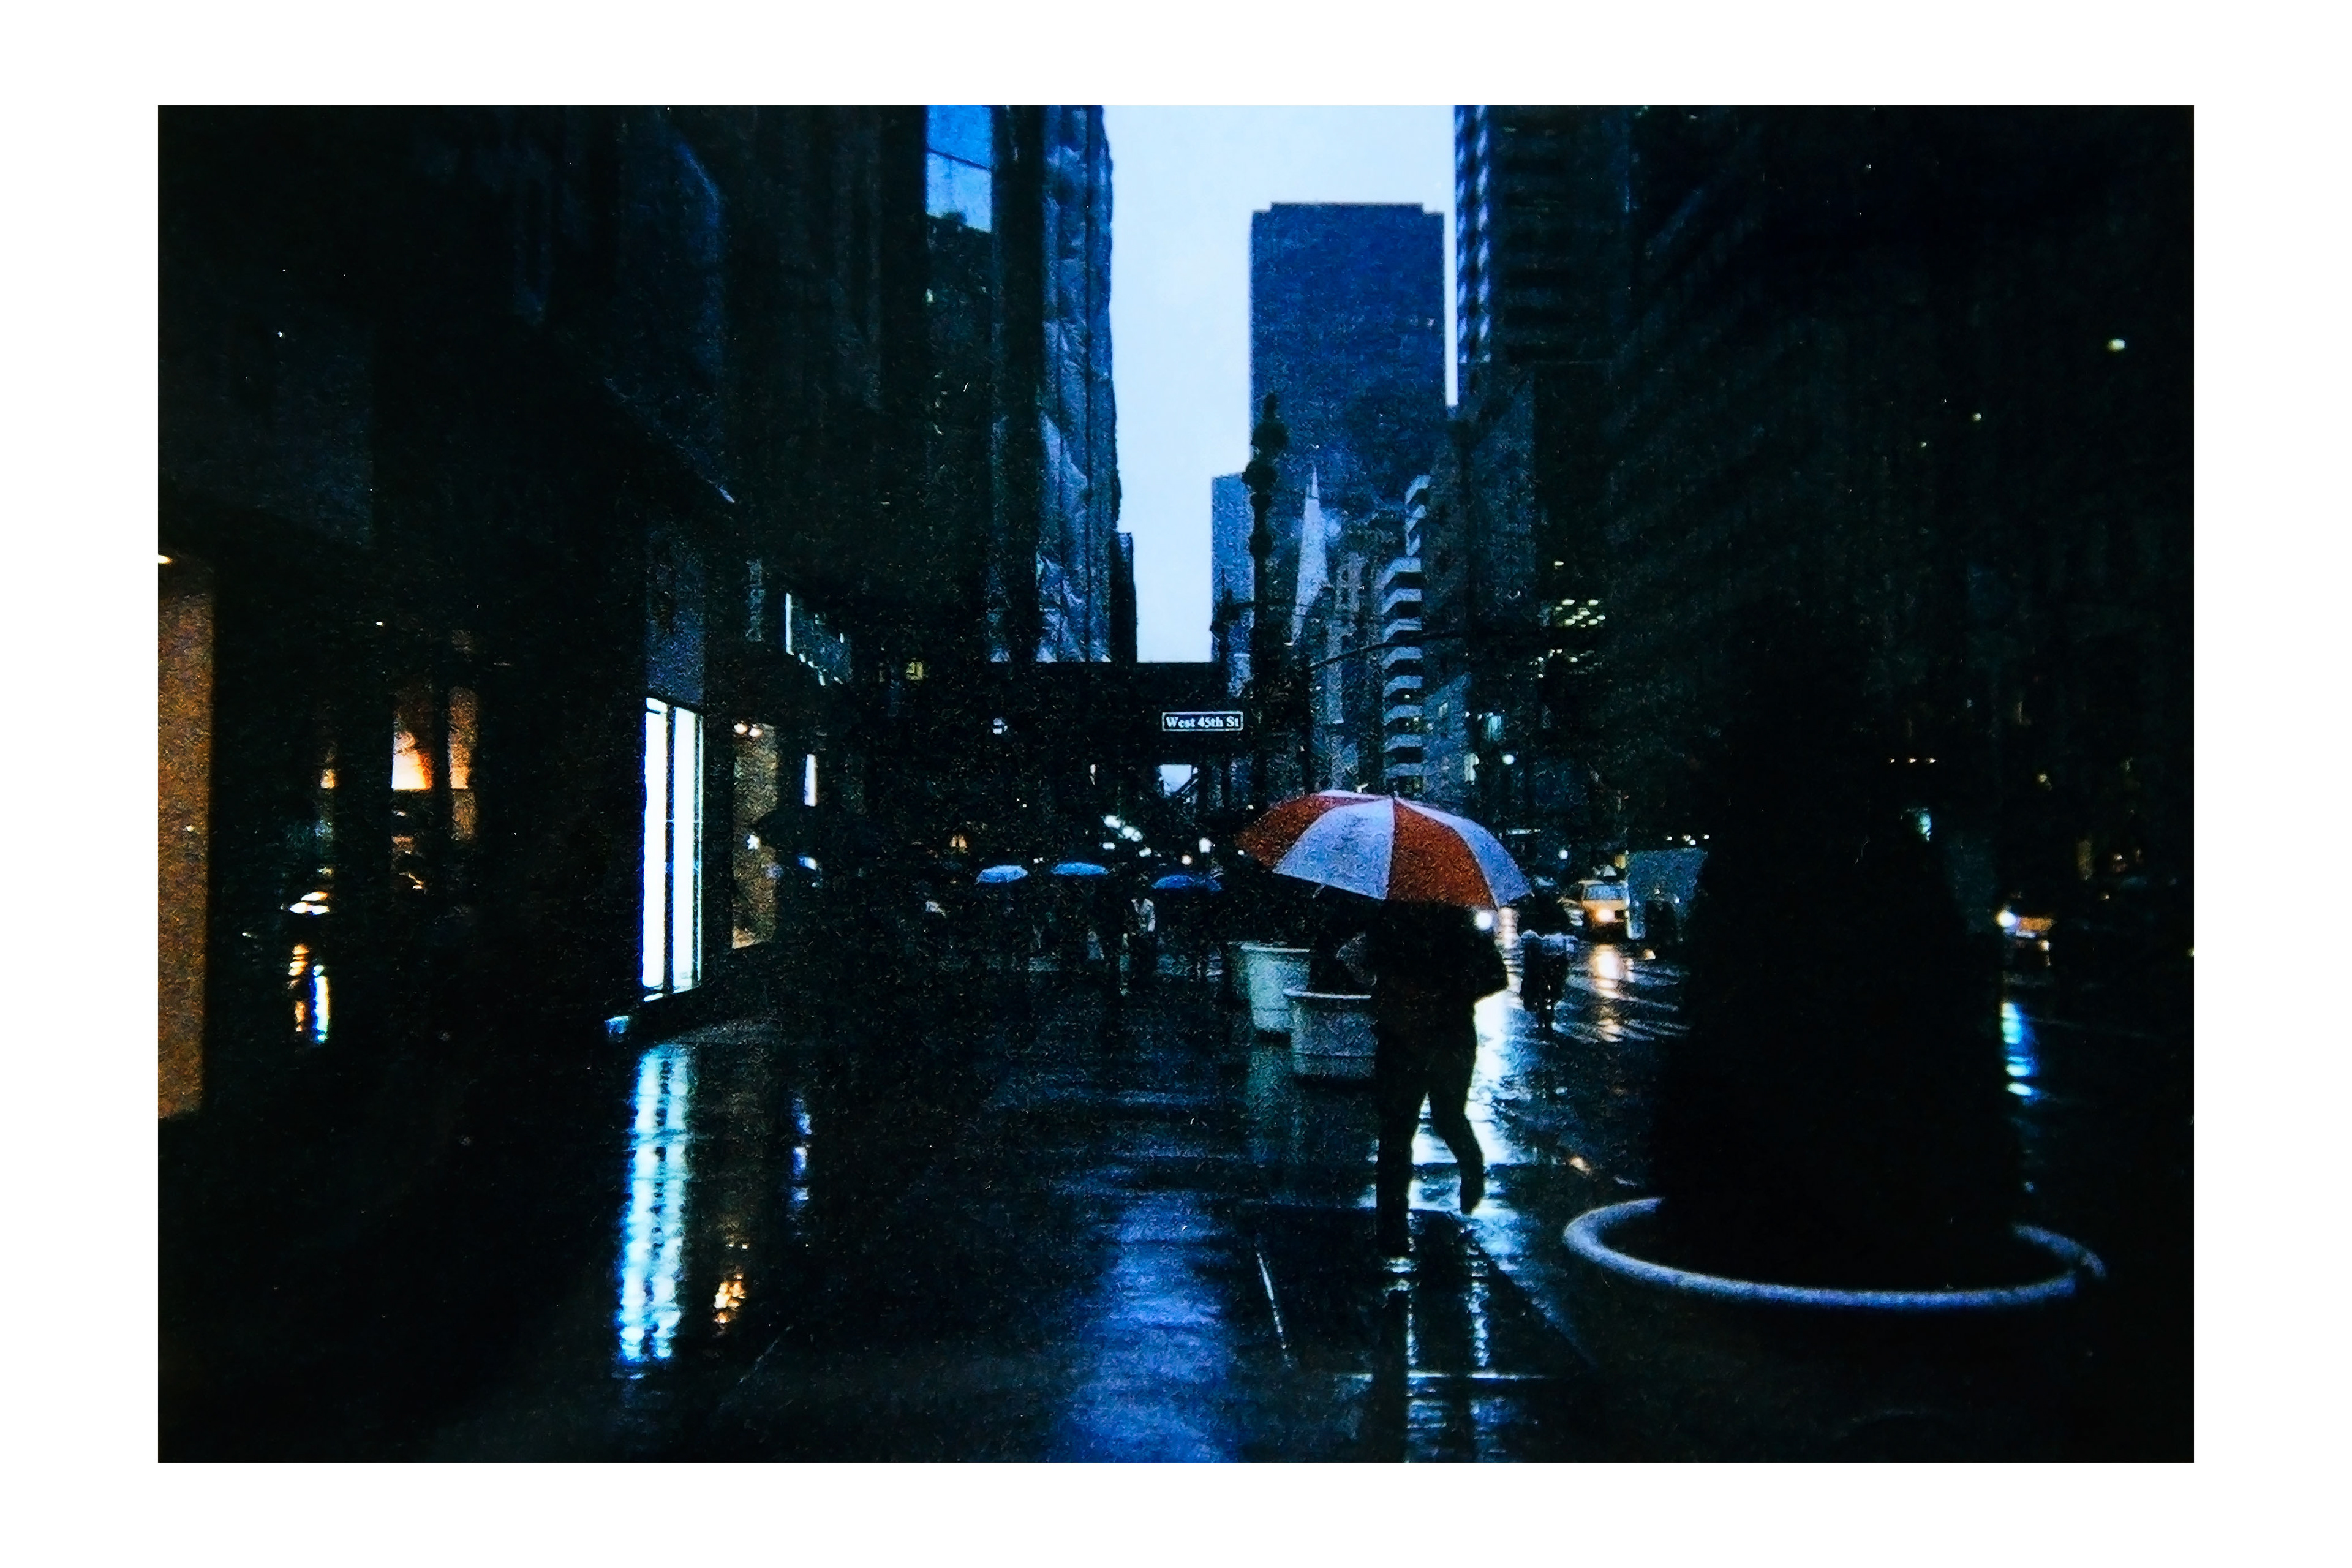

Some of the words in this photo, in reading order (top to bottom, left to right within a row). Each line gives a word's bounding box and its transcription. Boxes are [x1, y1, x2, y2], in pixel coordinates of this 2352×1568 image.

[1166, 717, 1196, 728] West
[1197, 716, 1223, 728] 45th
[1226, 715, 1239, 727] St
